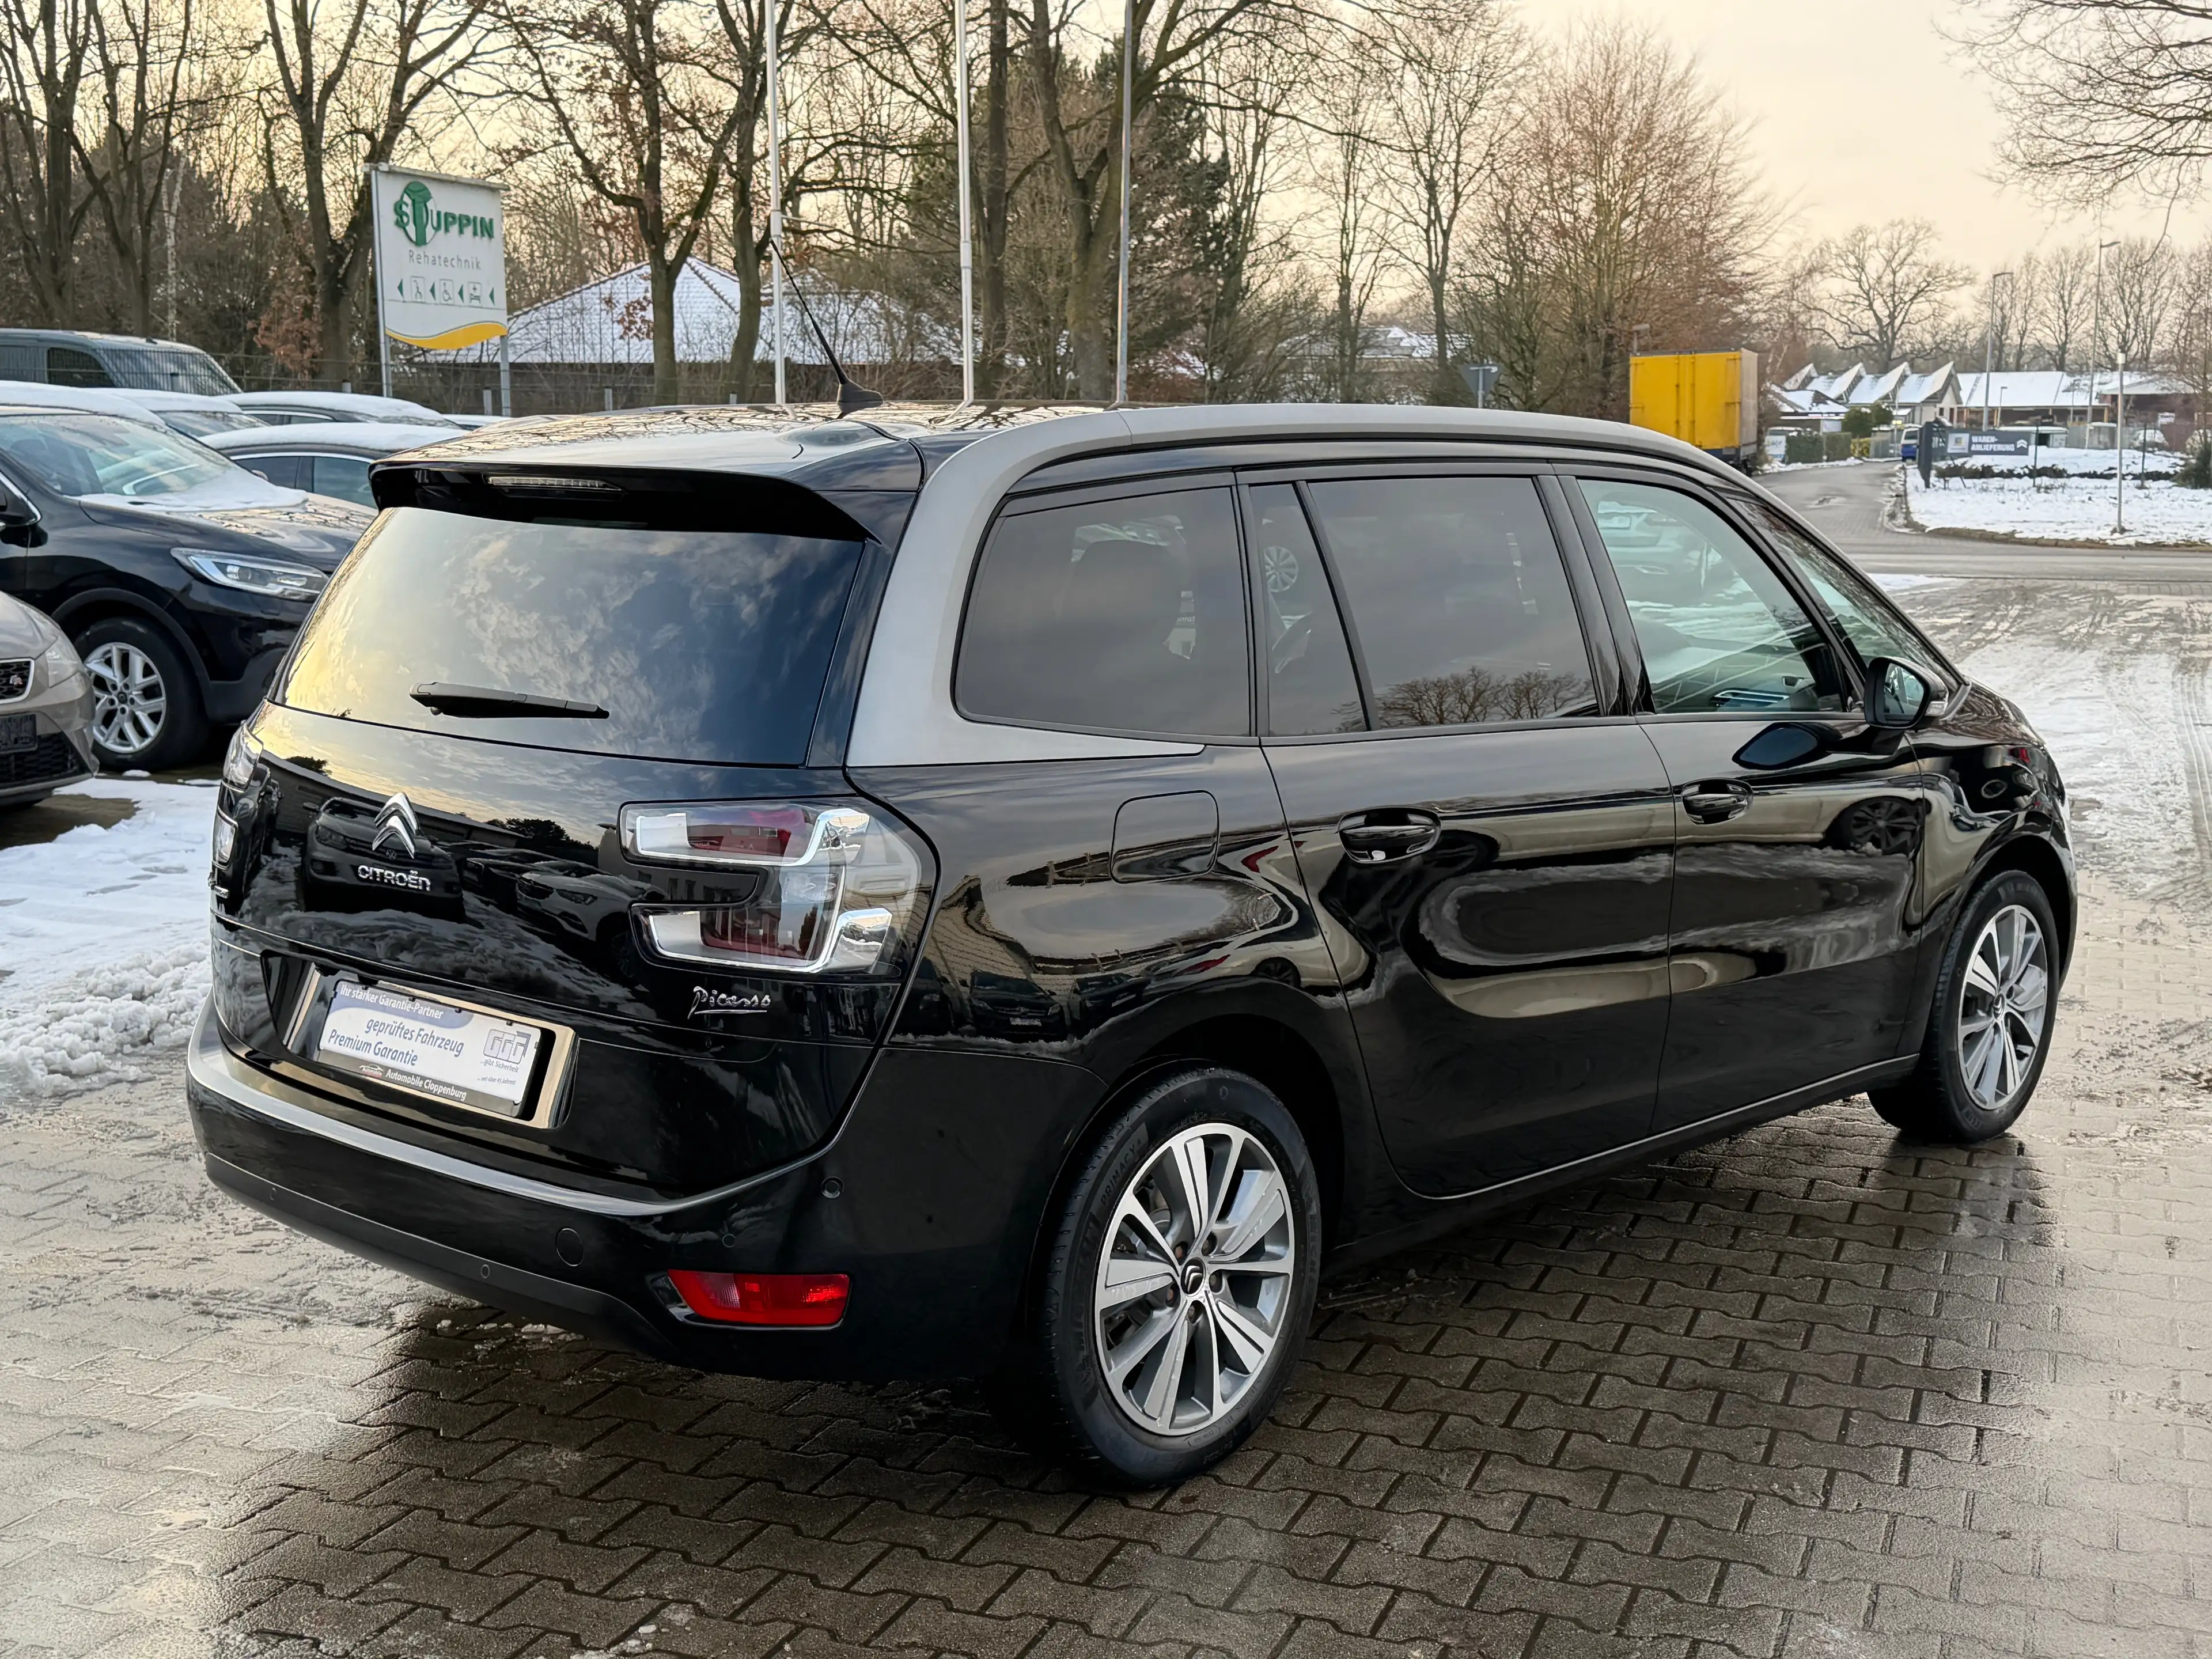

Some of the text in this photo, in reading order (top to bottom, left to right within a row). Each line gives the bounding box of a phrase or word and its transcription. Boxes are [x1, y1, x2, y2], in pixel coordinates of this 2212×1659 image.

[408, 249, 482, 270] Rehatechnik
[340, 984, 444, 1019] Ihr starker Garantie-Partner
[687, 986, 771, 1020] Picasso
[328, 1029, 418, 1066] Premium Garantie
[365, 1018, 465, 1058] geprüftes Fahrzeug
[495, 1061, 519, 1073] Sicherheit
[385, 1069, 467, 1101] Automobile Cloppenburg
[1100, 1144, 1138, 1206] PRIMACY
